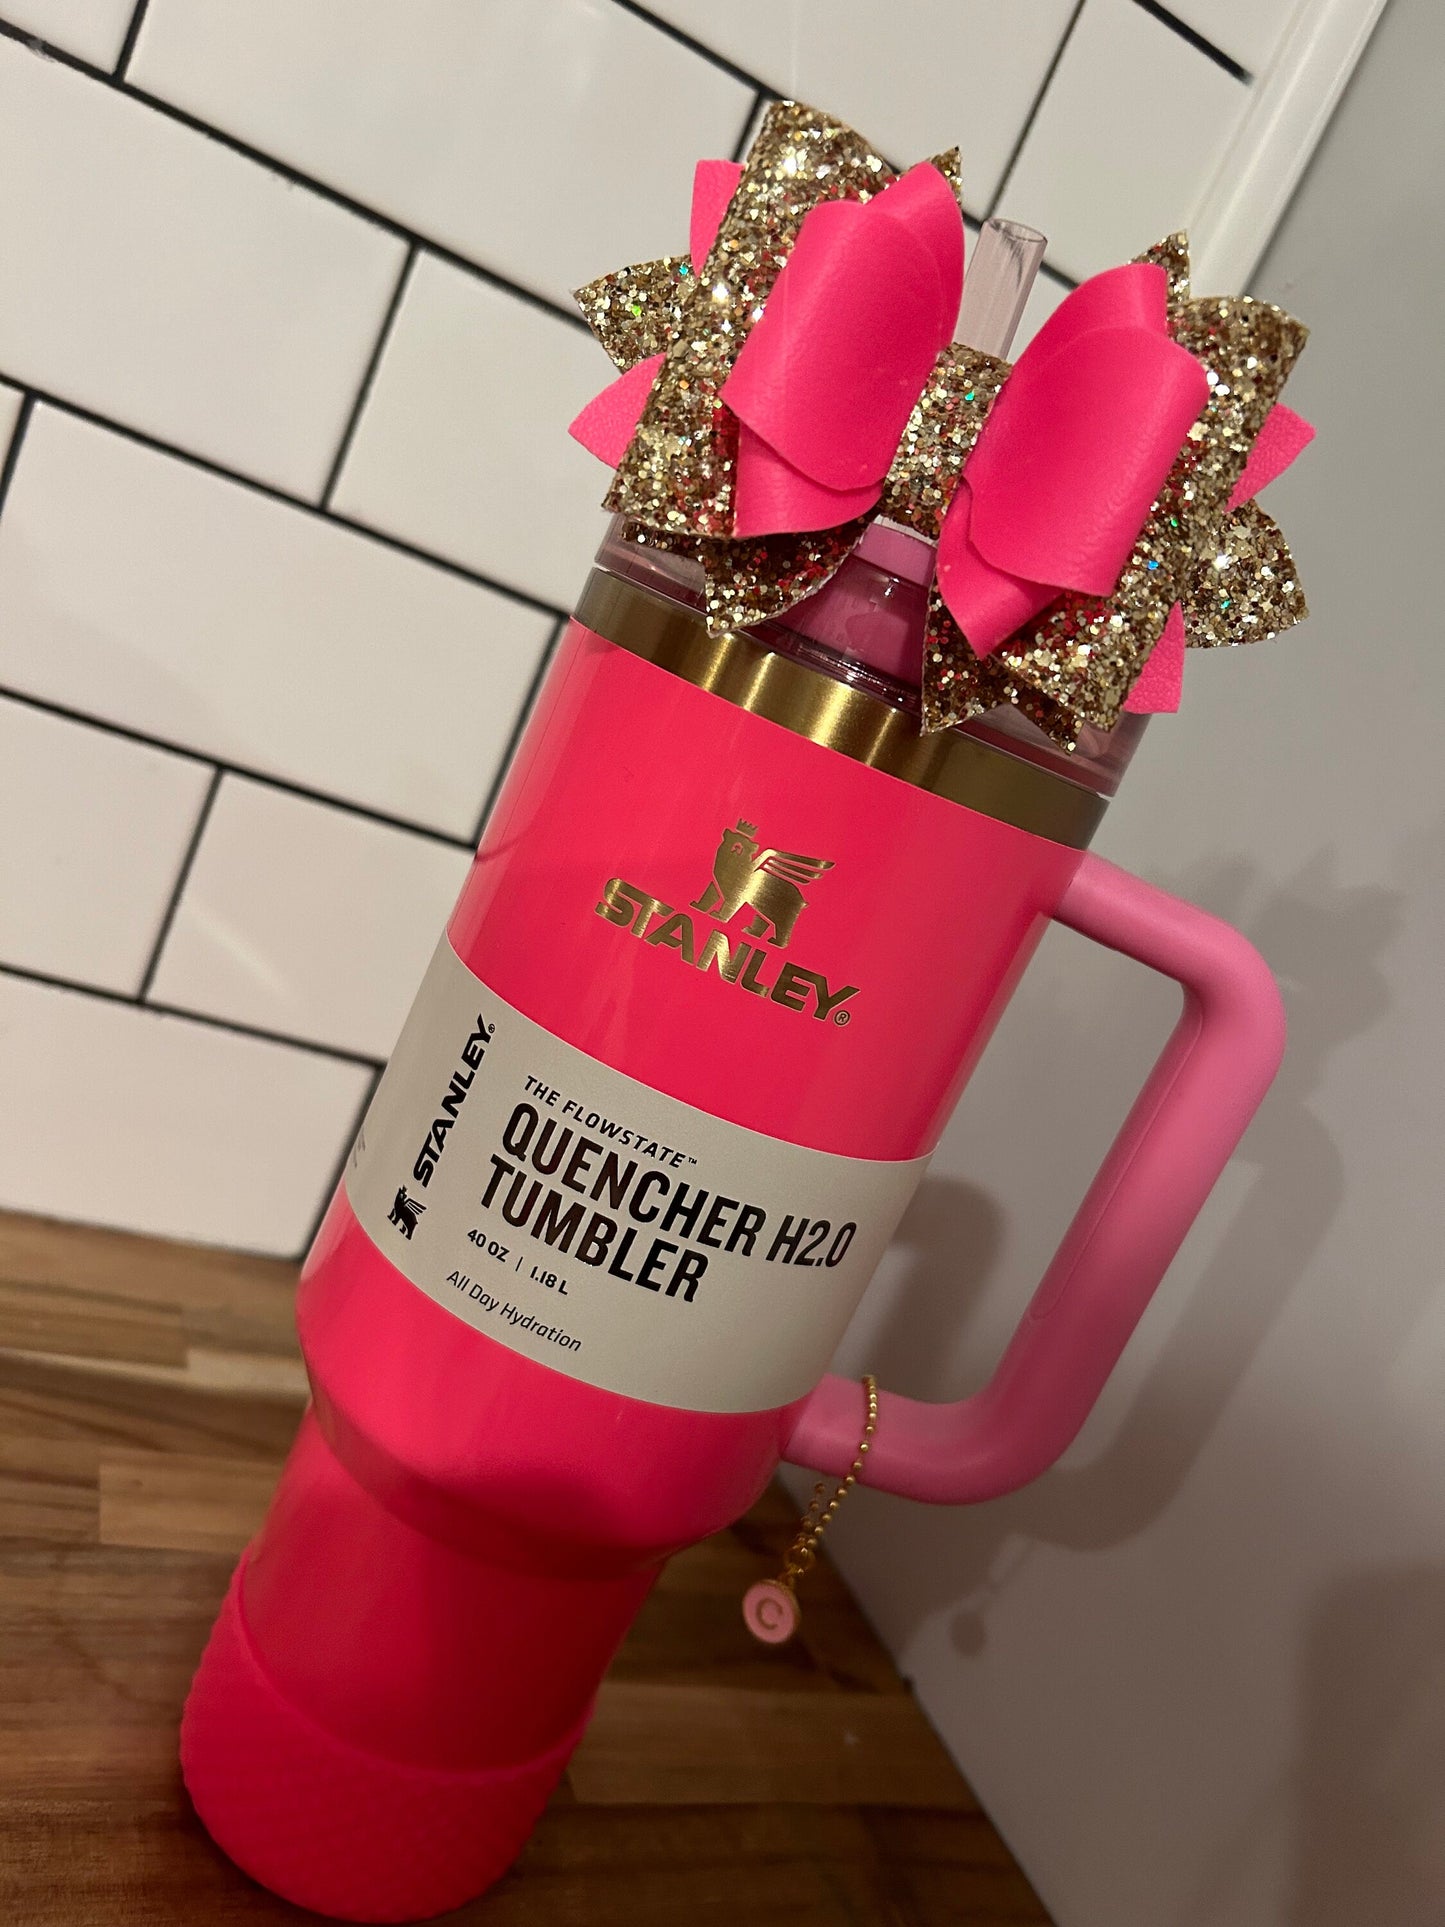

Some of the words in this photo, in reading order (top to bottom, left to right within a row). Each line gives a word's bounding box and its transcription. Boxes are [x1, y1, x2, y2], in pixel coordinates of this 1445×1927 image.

[524, 1075, 559, 1107] THE
[502, 1102, 768, 1258] QUENCHER
[766, 1214, 857, 1268] H2.0
[466, 1228, 487, 1249] 40
[487, 1240, 510, 1263] OZ
[530, 1265, 557, 1289] 1.18
[556, 1278, 569, 1296] L
[480, 1155, 710, 1303] TUMBLER
[446, 1270, 469, 1295] All
[468, 1285, 500, 1312] Day
[500, 1302, 582, 1352] Hydration
